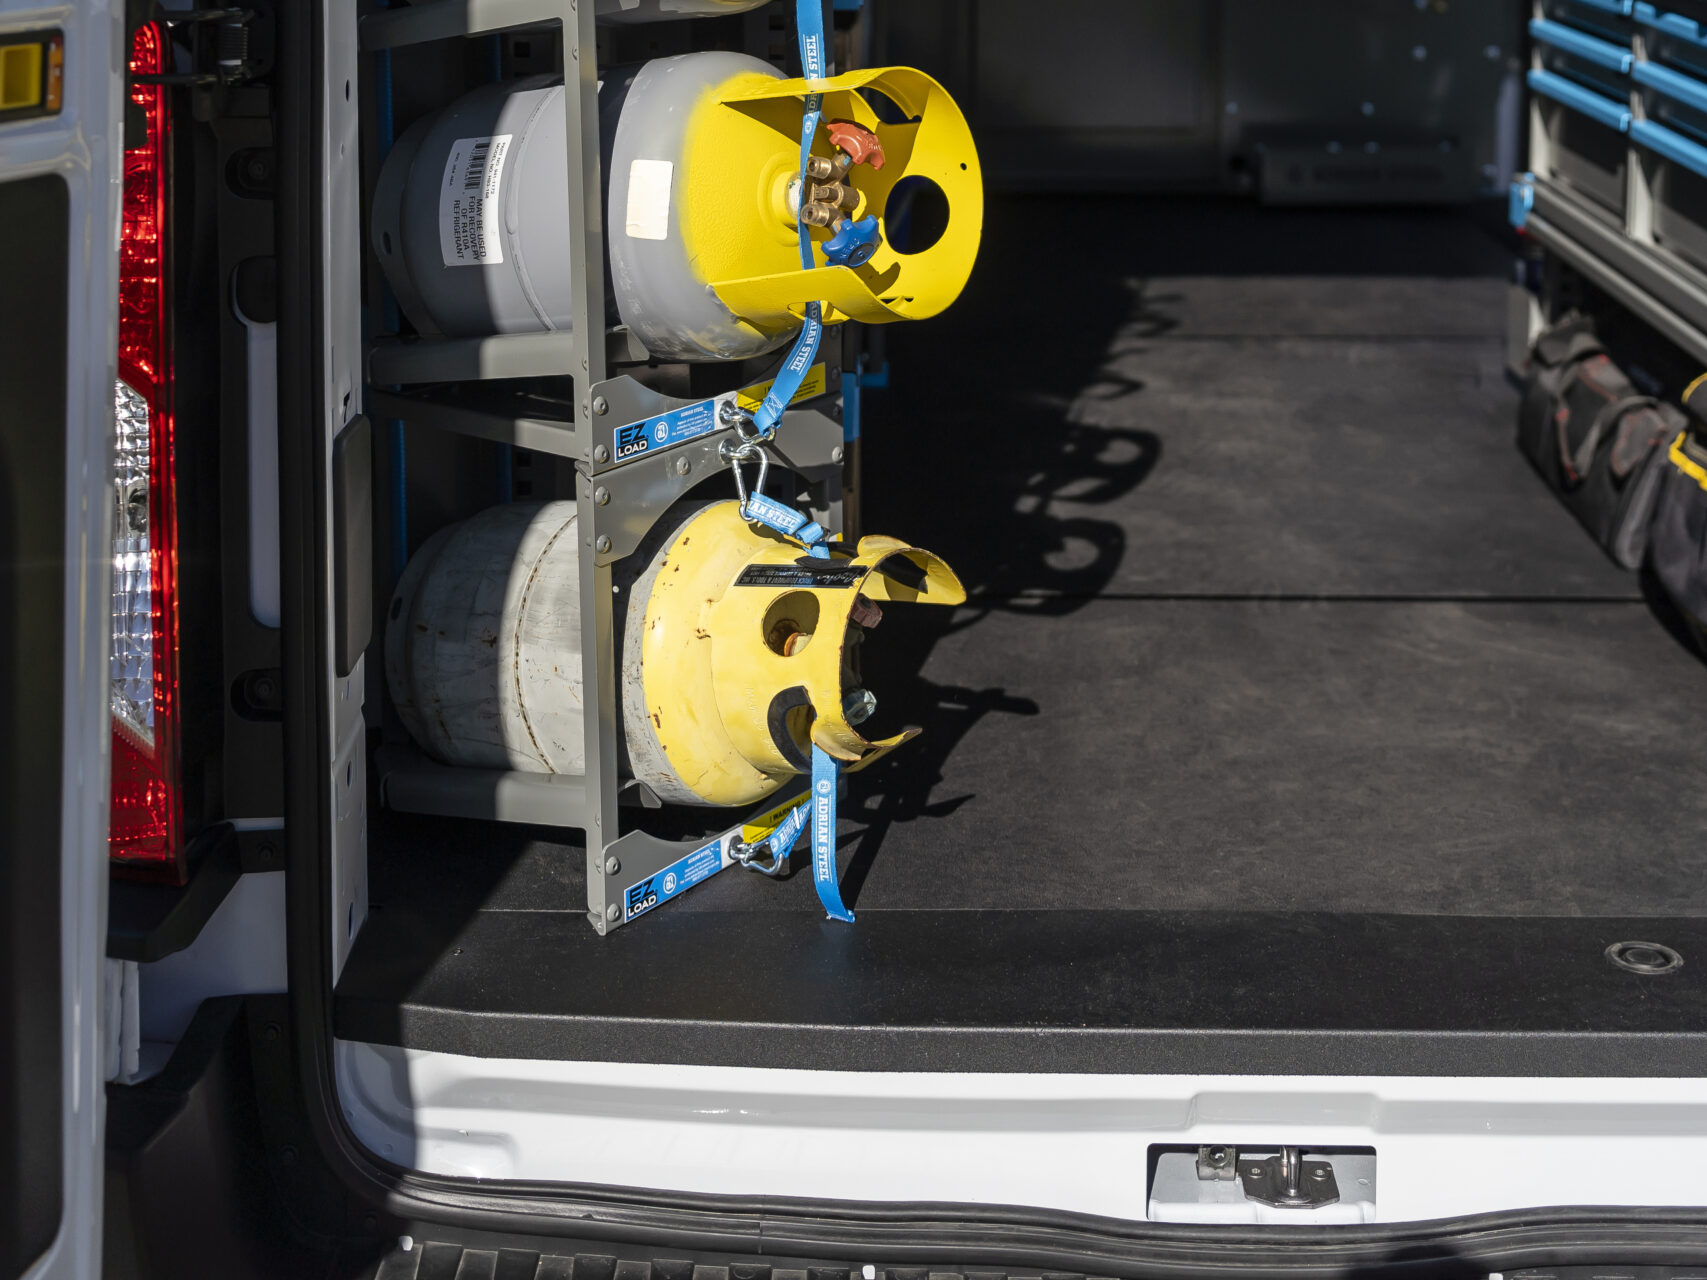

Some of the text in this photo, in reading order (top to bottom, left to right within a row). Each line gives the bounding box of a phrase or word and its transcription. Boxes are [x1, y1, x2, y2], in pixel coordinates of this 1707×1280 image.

[805, 35, 818, 70] STEEL
[453, 199, 464, 259] REFRIGERANT
[460, 208, 469, 250] OF R410A
[467, 216, 480, 260] RECOVERY
[475, 219, 483, 231] BE
[477, 233, 486, 257] USED
[789, 345, 810, 373] STEEL
[617, 424, 647, 446] EZ
[617, 440, 648, 458] LOAD
[766, 507, 796, 527] STEEL
[817, 796, 829, 880] ADRIAN STEEL
[627, 893, 656, 917] LOAD
[629, 877, 655, 905] EZ
